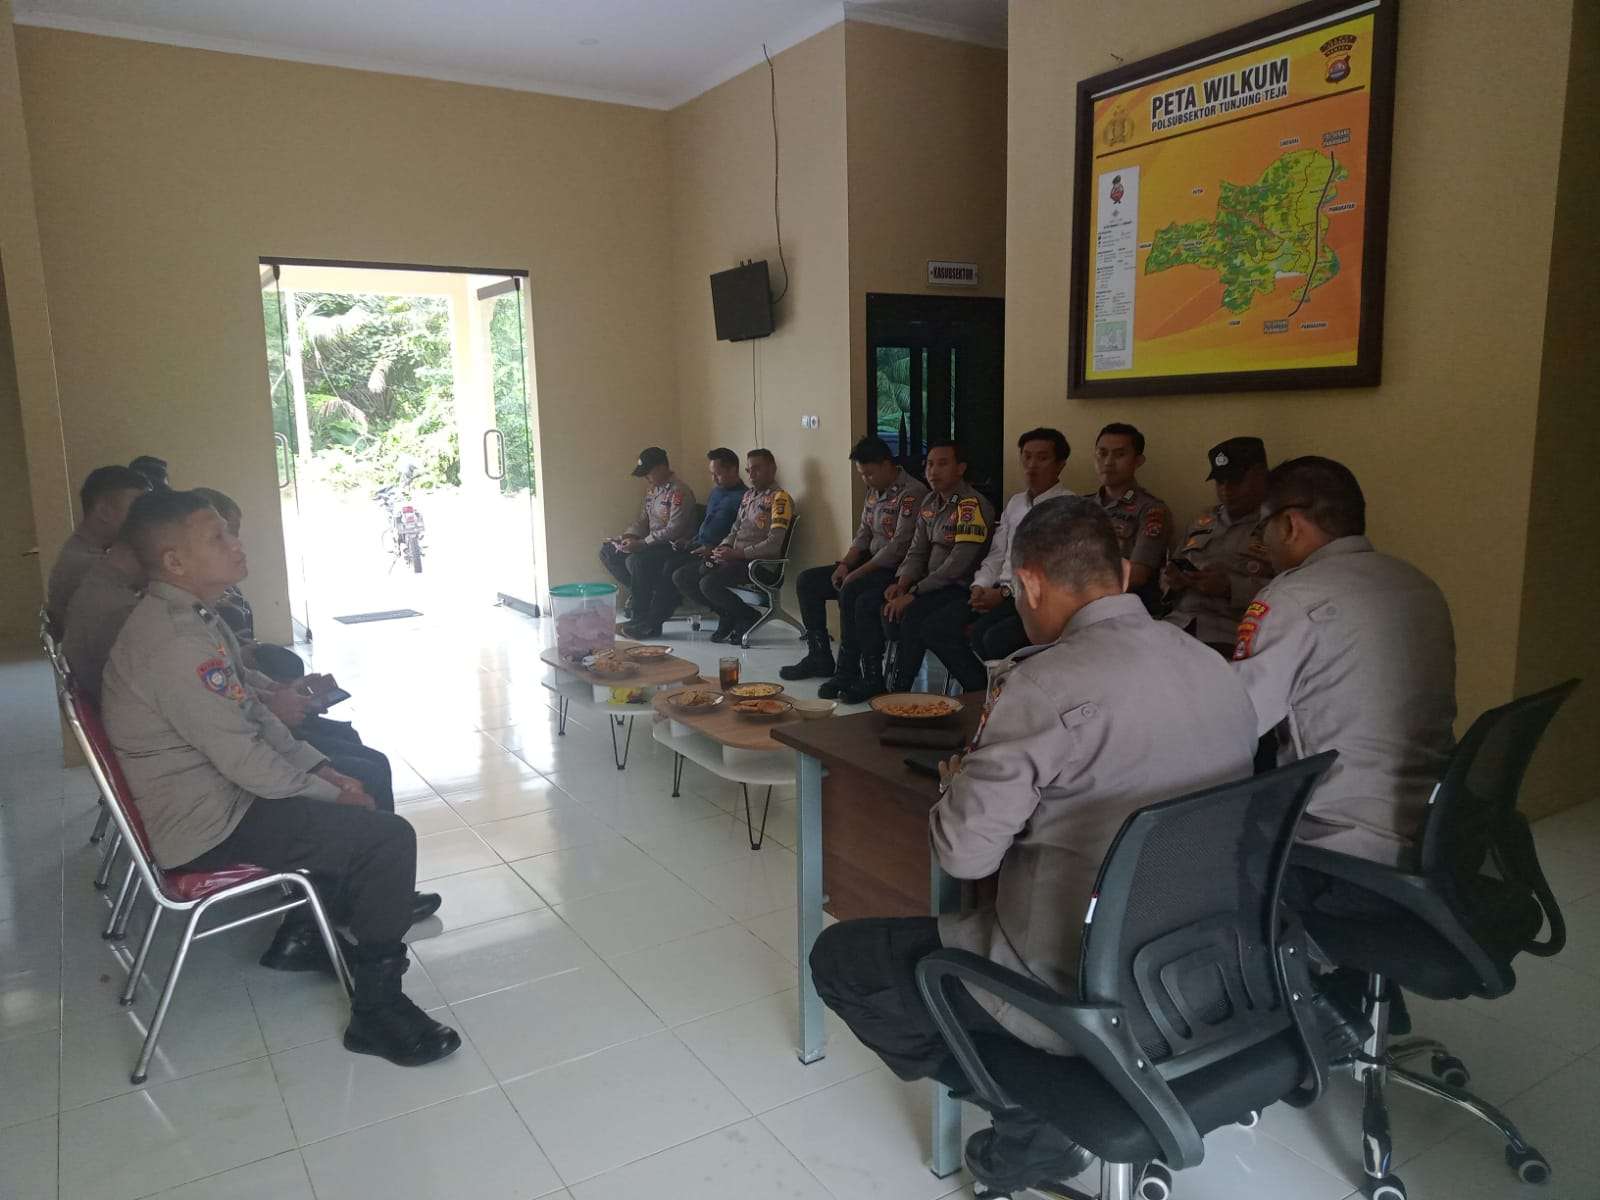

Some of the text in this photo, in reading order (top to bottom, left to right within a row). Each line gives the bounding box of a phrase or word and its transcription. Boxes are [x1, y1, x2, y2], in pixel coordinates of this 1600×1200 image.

[1152, 58, 1288, 120] PETA WILKUM
[1152, 84, 1288, 132] POLSUBSEKTOR TUNJUNG TEJA
